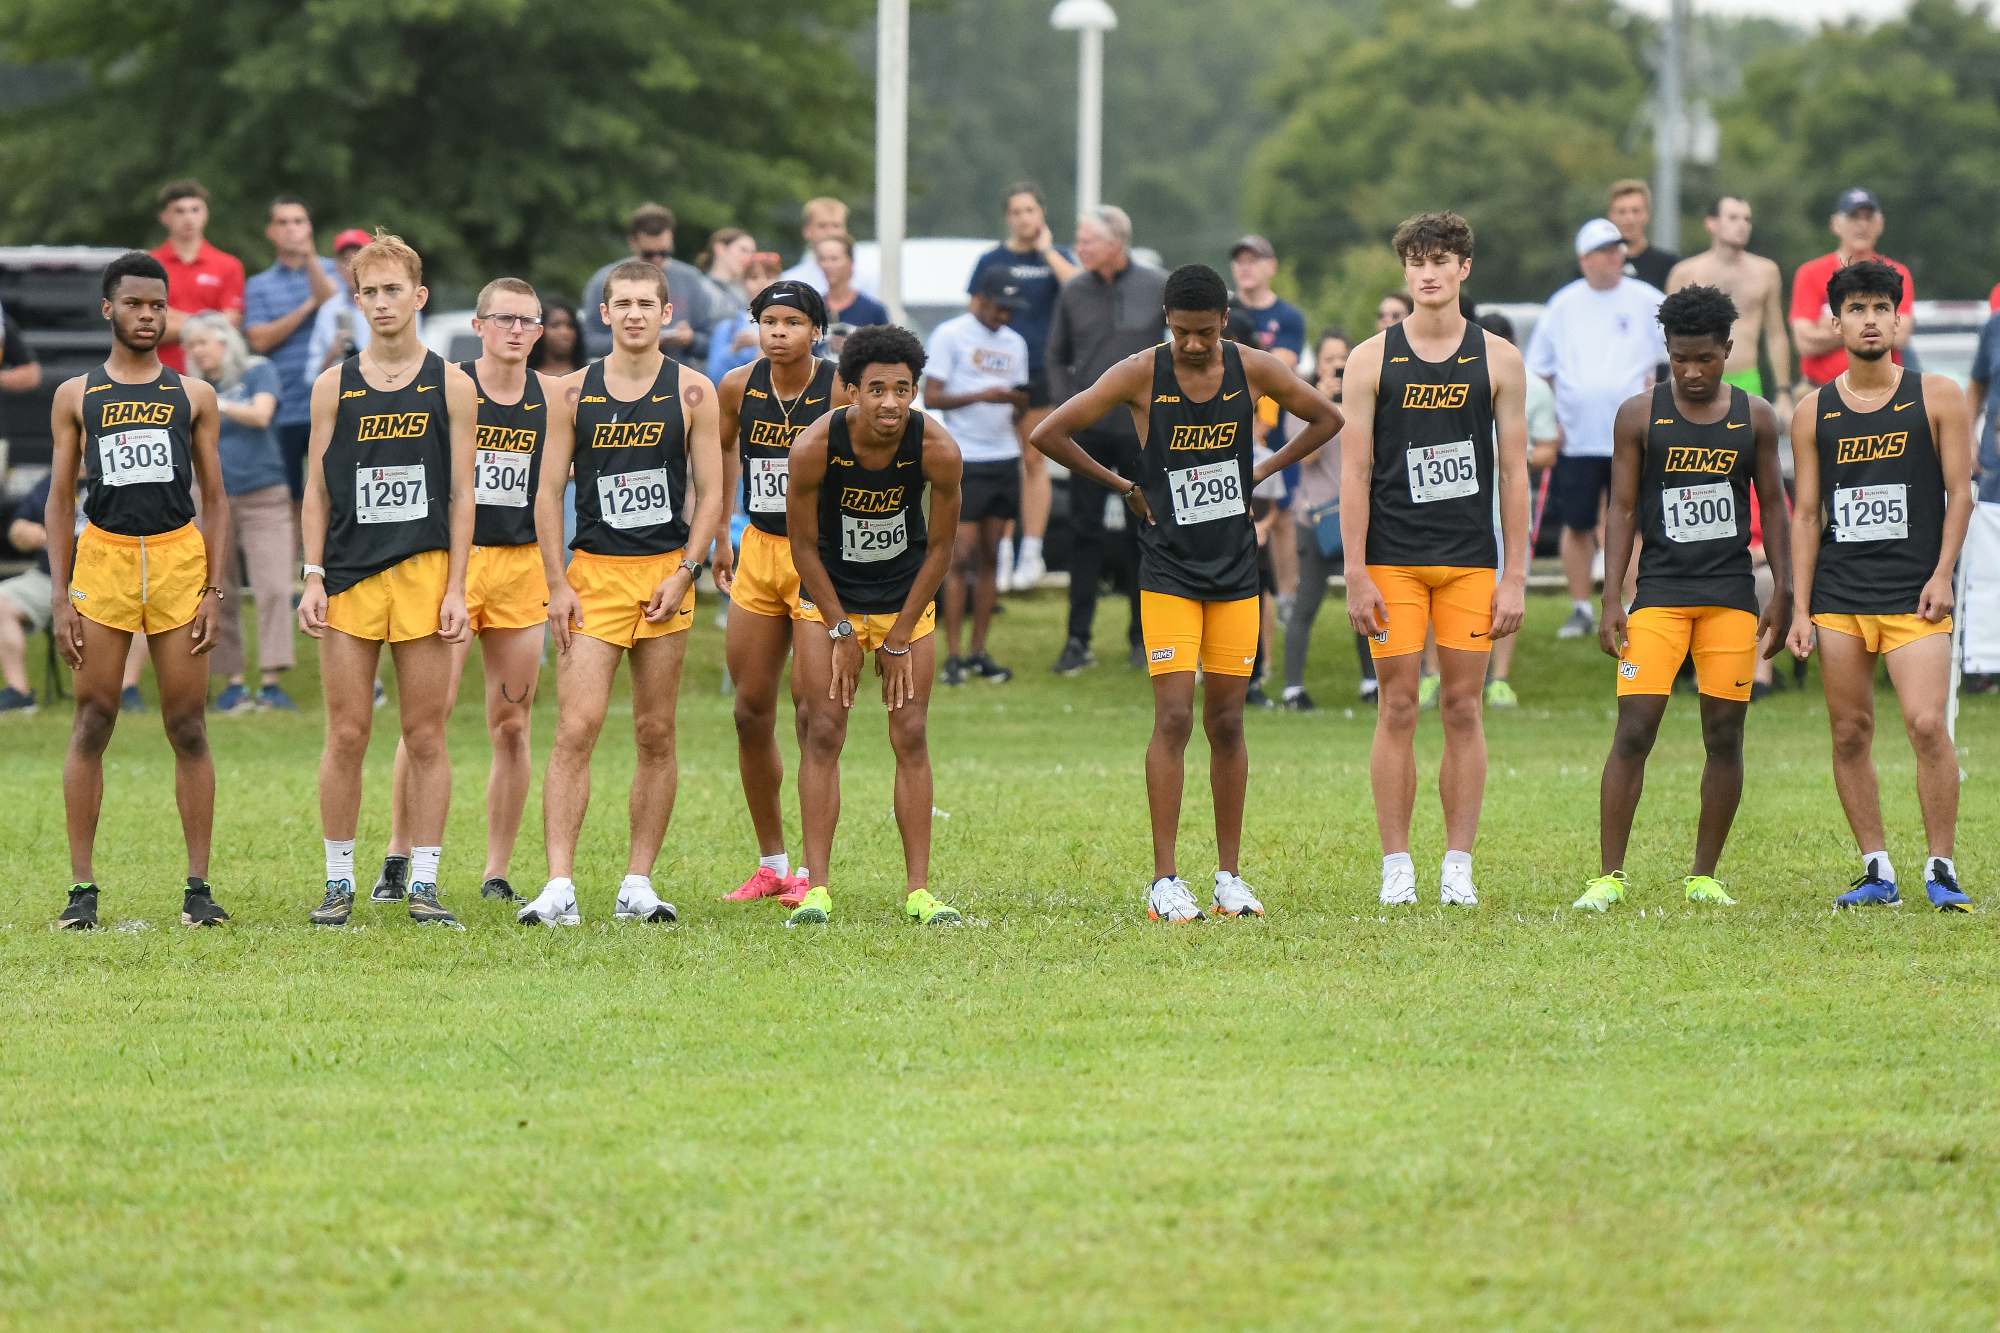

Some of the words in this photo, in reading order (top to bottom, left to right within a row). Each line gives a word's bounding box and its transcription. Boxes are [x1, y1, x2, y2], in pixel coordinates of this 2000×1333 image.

[1402, 384, 1470, 409] RAMS
[102, 402, 174, 427] RAMS
[358, 413, 429, 441] RAMS
[476, 425, 537, 453] RAMS
[592, 422, 665, 448] RAMS
[750, 420, 809, 447] RAM
[1170, 422, 1238, 450] RAMS
[1837, 431, 1908, 464] RAMS
[104, 442, 168, 473] 1303
[1412, 456, 1473, 487] 1305
[1665, 447, 1738, 474] RAMS
[475, 465, 526, 492] 1304
[1175, 475, 1238, 509] 1298
[360, 480, 422, 507] 1297
[603, 483, 666, 515] 1299
[1668, 498, 1732, 528] 1300
[1840, 499, 1904, 527] 1295
[846, 523, 905, 550] 1296
[1152, 650, 1173, 660] RAMS
